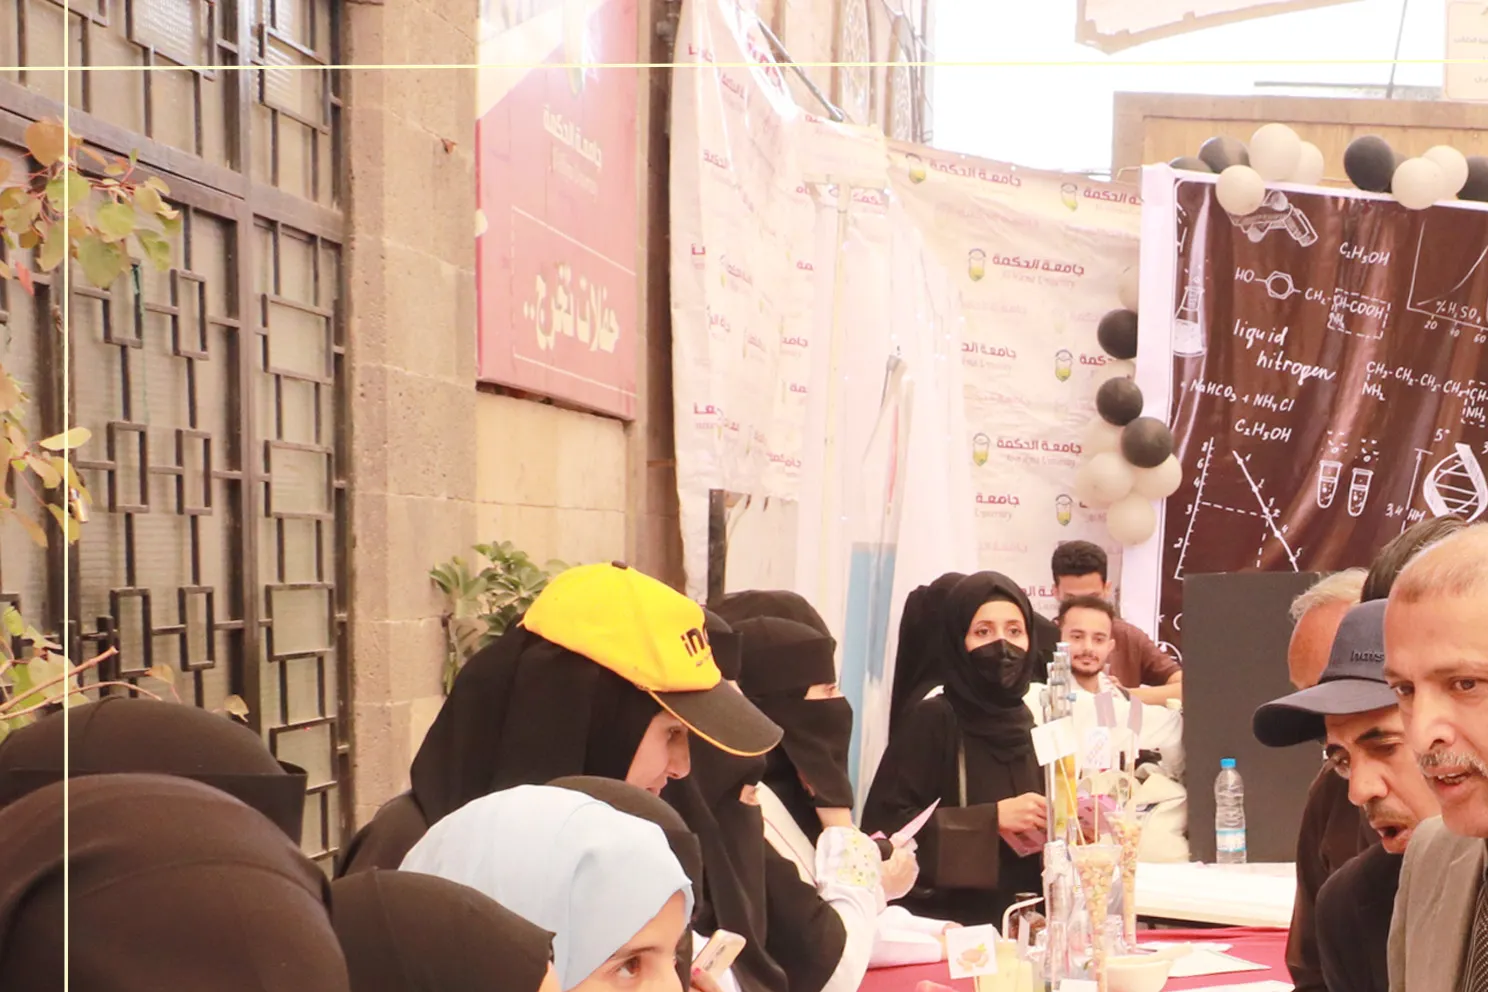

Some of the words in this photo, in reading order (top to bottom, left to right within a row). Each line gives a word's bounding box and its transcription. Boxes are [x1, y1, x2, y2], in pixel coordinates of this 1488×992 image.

[992, 253, 1040, 271] الحكمة
[1041, 259, 1085, 277] جامعة
[1234, 267, 1255, 283] HO
[1423, 319, 1439, 331] 20
[1232, 318, 1289, 350] liquid
[996, 437, 1040, 451] الحكمة
[1041, 438, 1083, 456] جامعة
[975, 492, 1021, 508] جامعة
